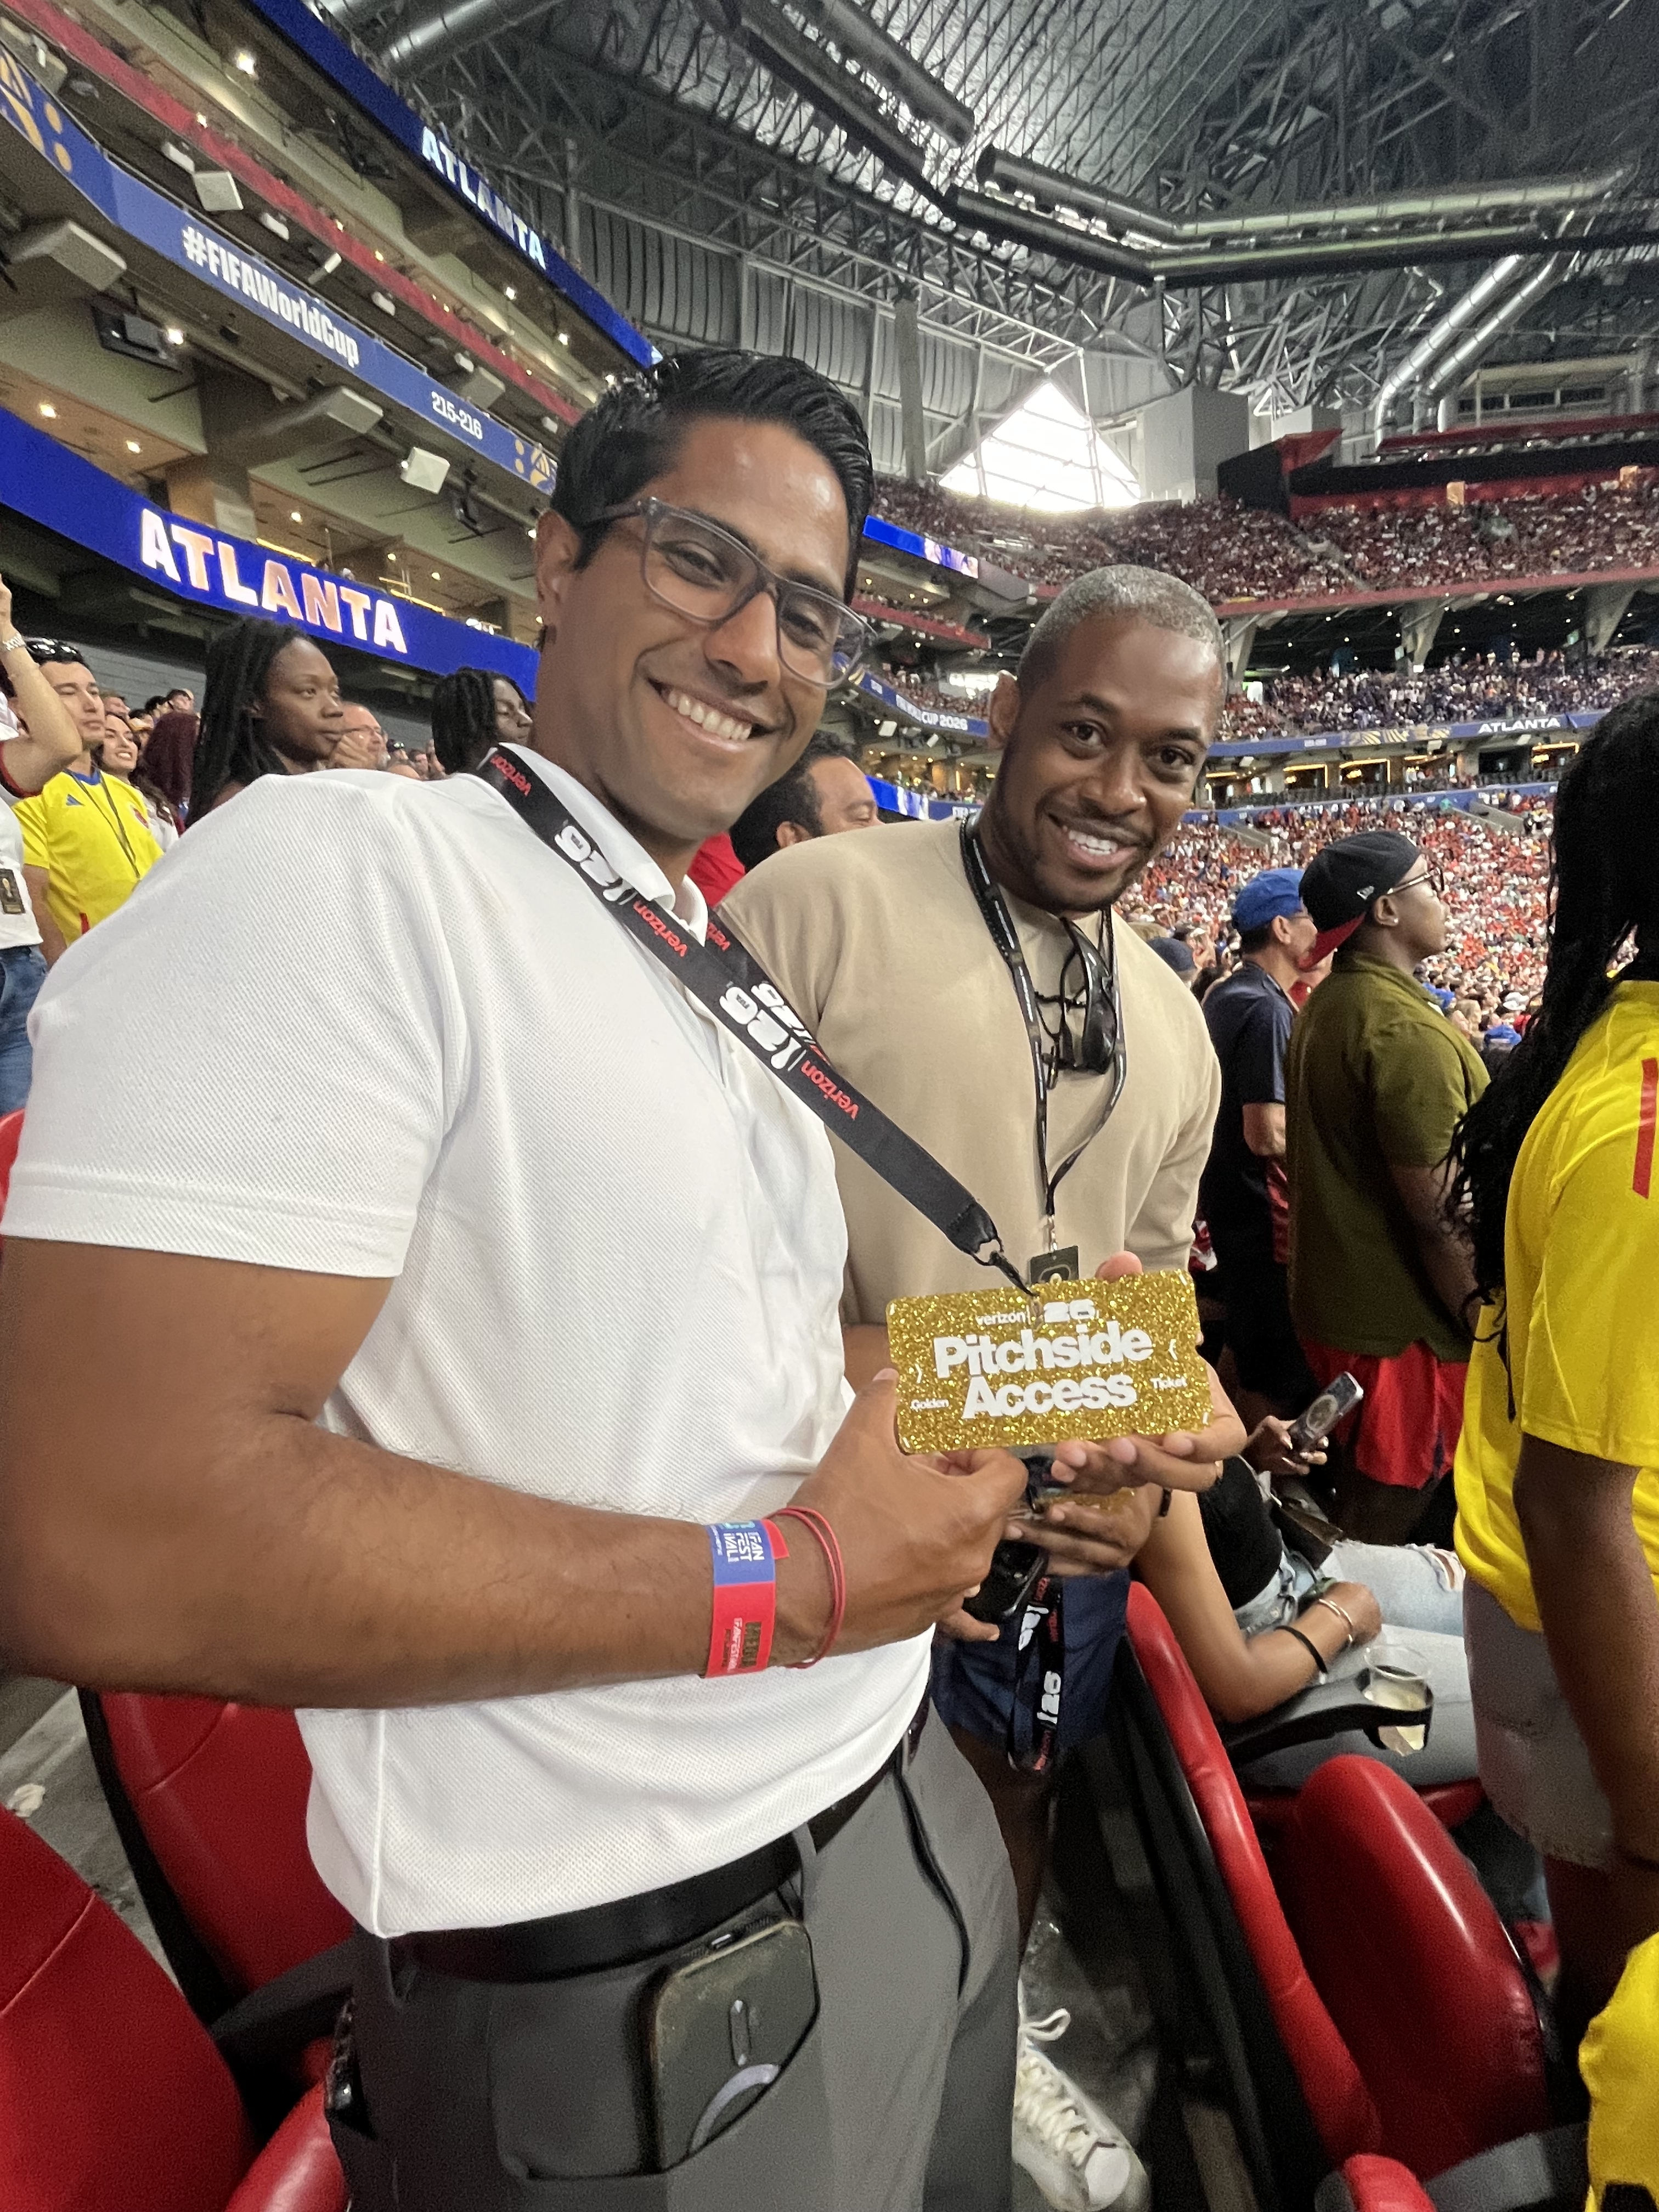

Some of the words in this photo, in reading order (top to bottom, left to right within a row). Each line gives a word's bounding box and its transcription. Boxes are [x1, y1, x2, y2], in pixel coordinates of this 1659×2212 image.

[422, 126, 546, 270] ATLANTA
[182, 225, 360, 368] #FIFAWorldCup
[431, 391, 483, 440] 215-216
[141, 508, 408, 654] ATLANTA
[1477, 717, 1561, 734] ATLANTA
[490, 754, 532, 795] verizon
[633, 900, 687, 957] verizon
[800, 1059, 859, 1120] verizon
[976, 1311, 1026, 1325] verizon
[934, 1321, 1154, 1379] Pitchside
[962, 1374, 1137, 1419] Access
[736, 1532, 752, 1562] FEST
[748, 1532, 765, 1560] FAN
